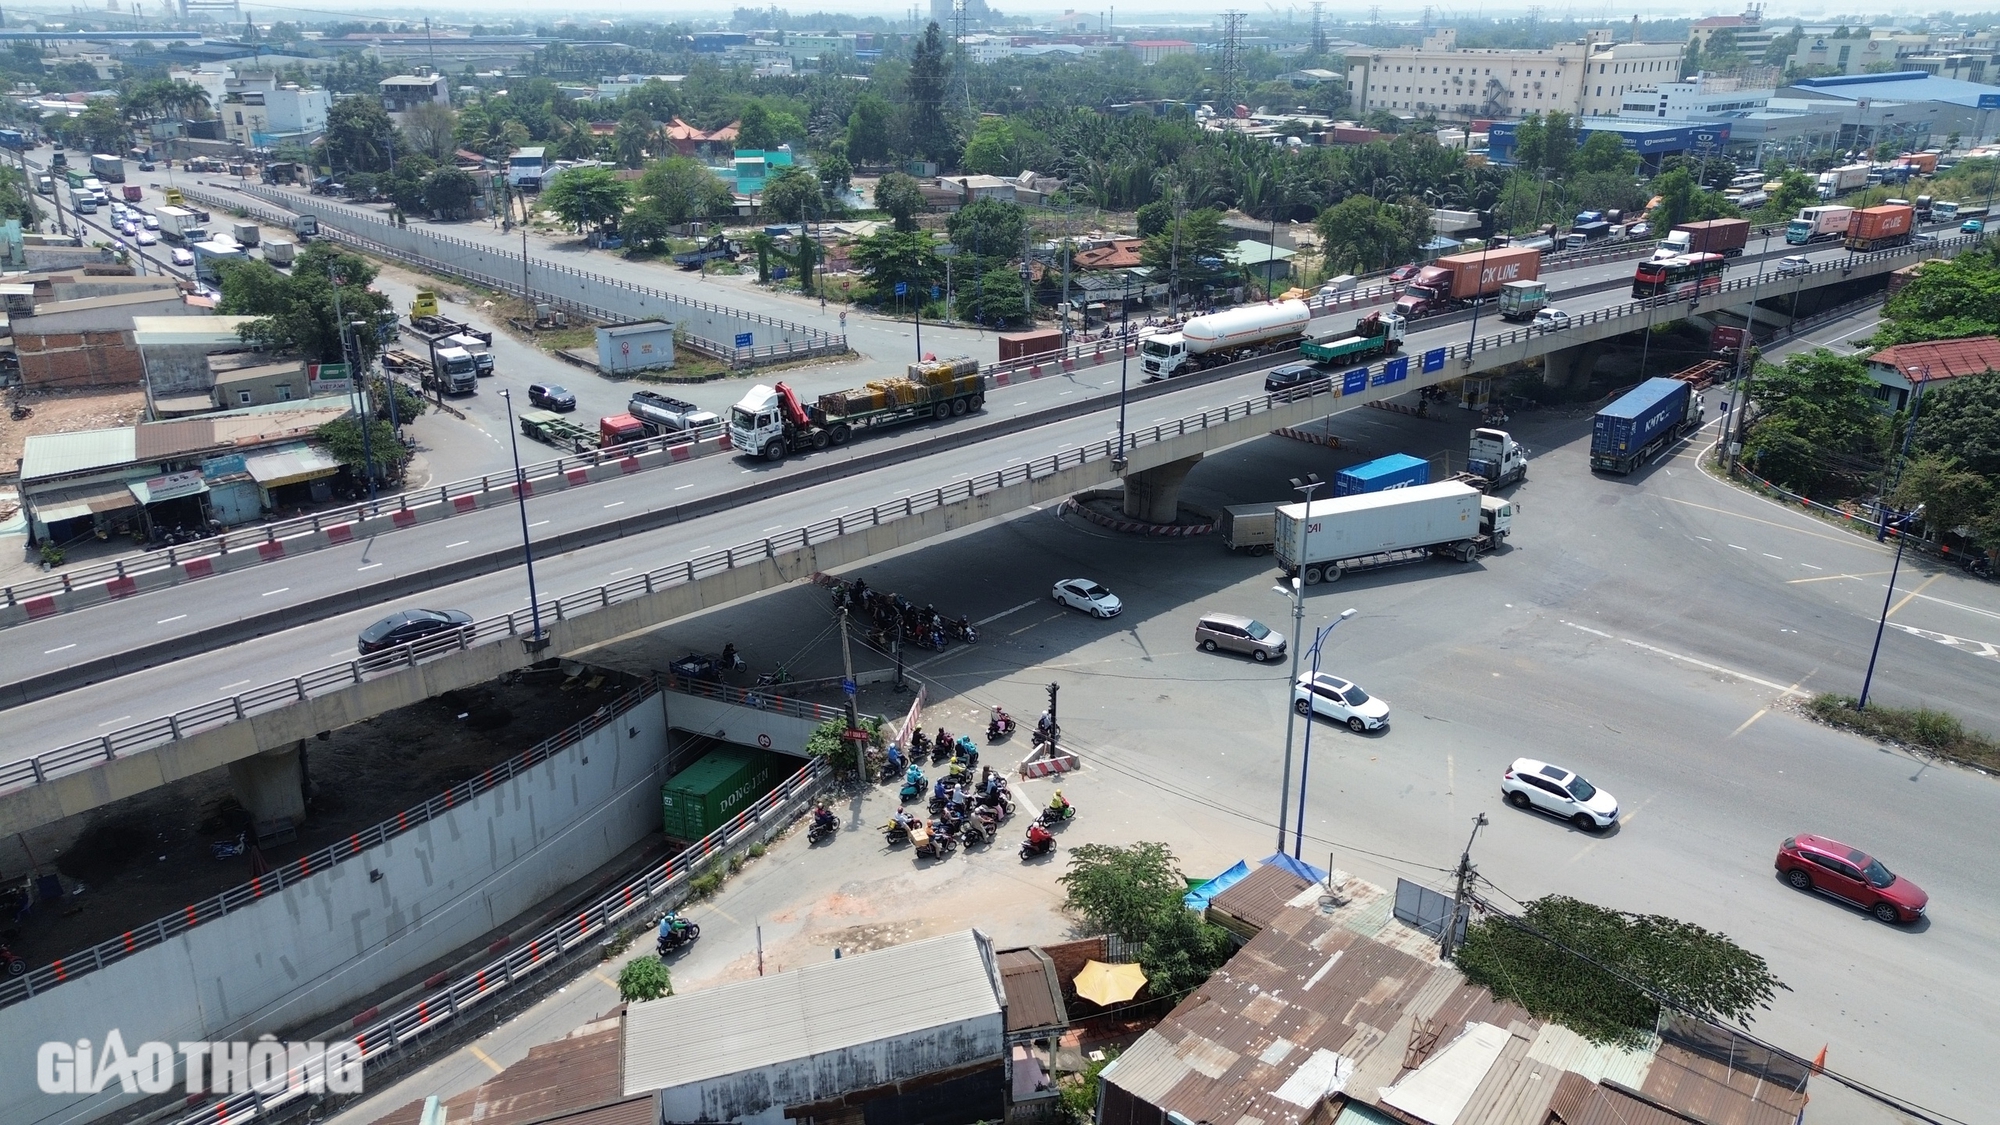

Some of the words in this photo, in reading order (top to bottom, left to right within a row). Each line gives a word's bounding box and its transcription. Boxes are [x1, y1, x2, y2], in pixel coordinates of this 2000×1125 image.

[1497, 263, 1520, 281] LINE
[720, 782, 750, 813] DONG
[751, 767, 769, 790] JIN
